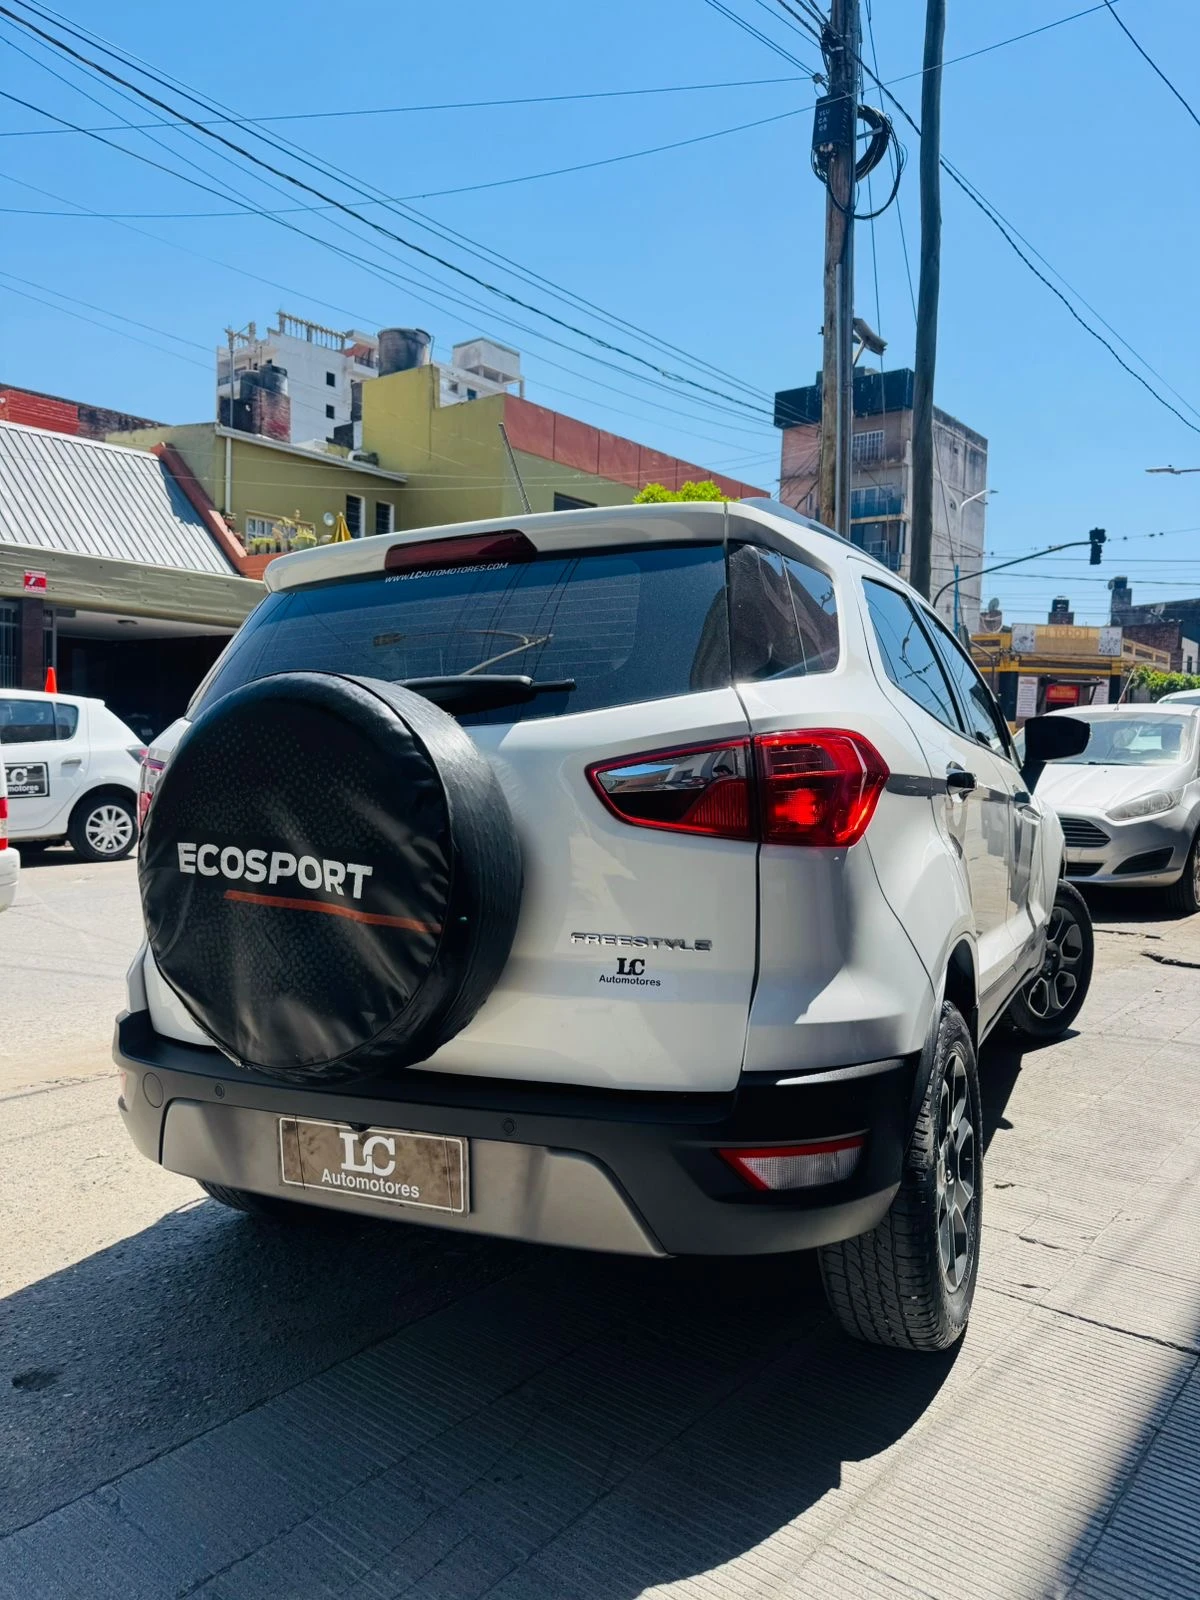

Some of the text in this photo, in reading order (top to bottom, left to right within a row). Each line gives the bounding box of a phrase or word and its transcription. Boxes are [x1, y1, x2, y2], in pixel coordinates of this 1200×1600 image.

[177, 842, 374, 899] ECOSPORT
[570, 932, 712, 951] FREESTYLE
[616, 957, 646, 976] LC
[599, 974, 662, 987] Automotores
[339, 1131, 396, 1177] LC
[321, 1168, 420, 1199] Automotores
